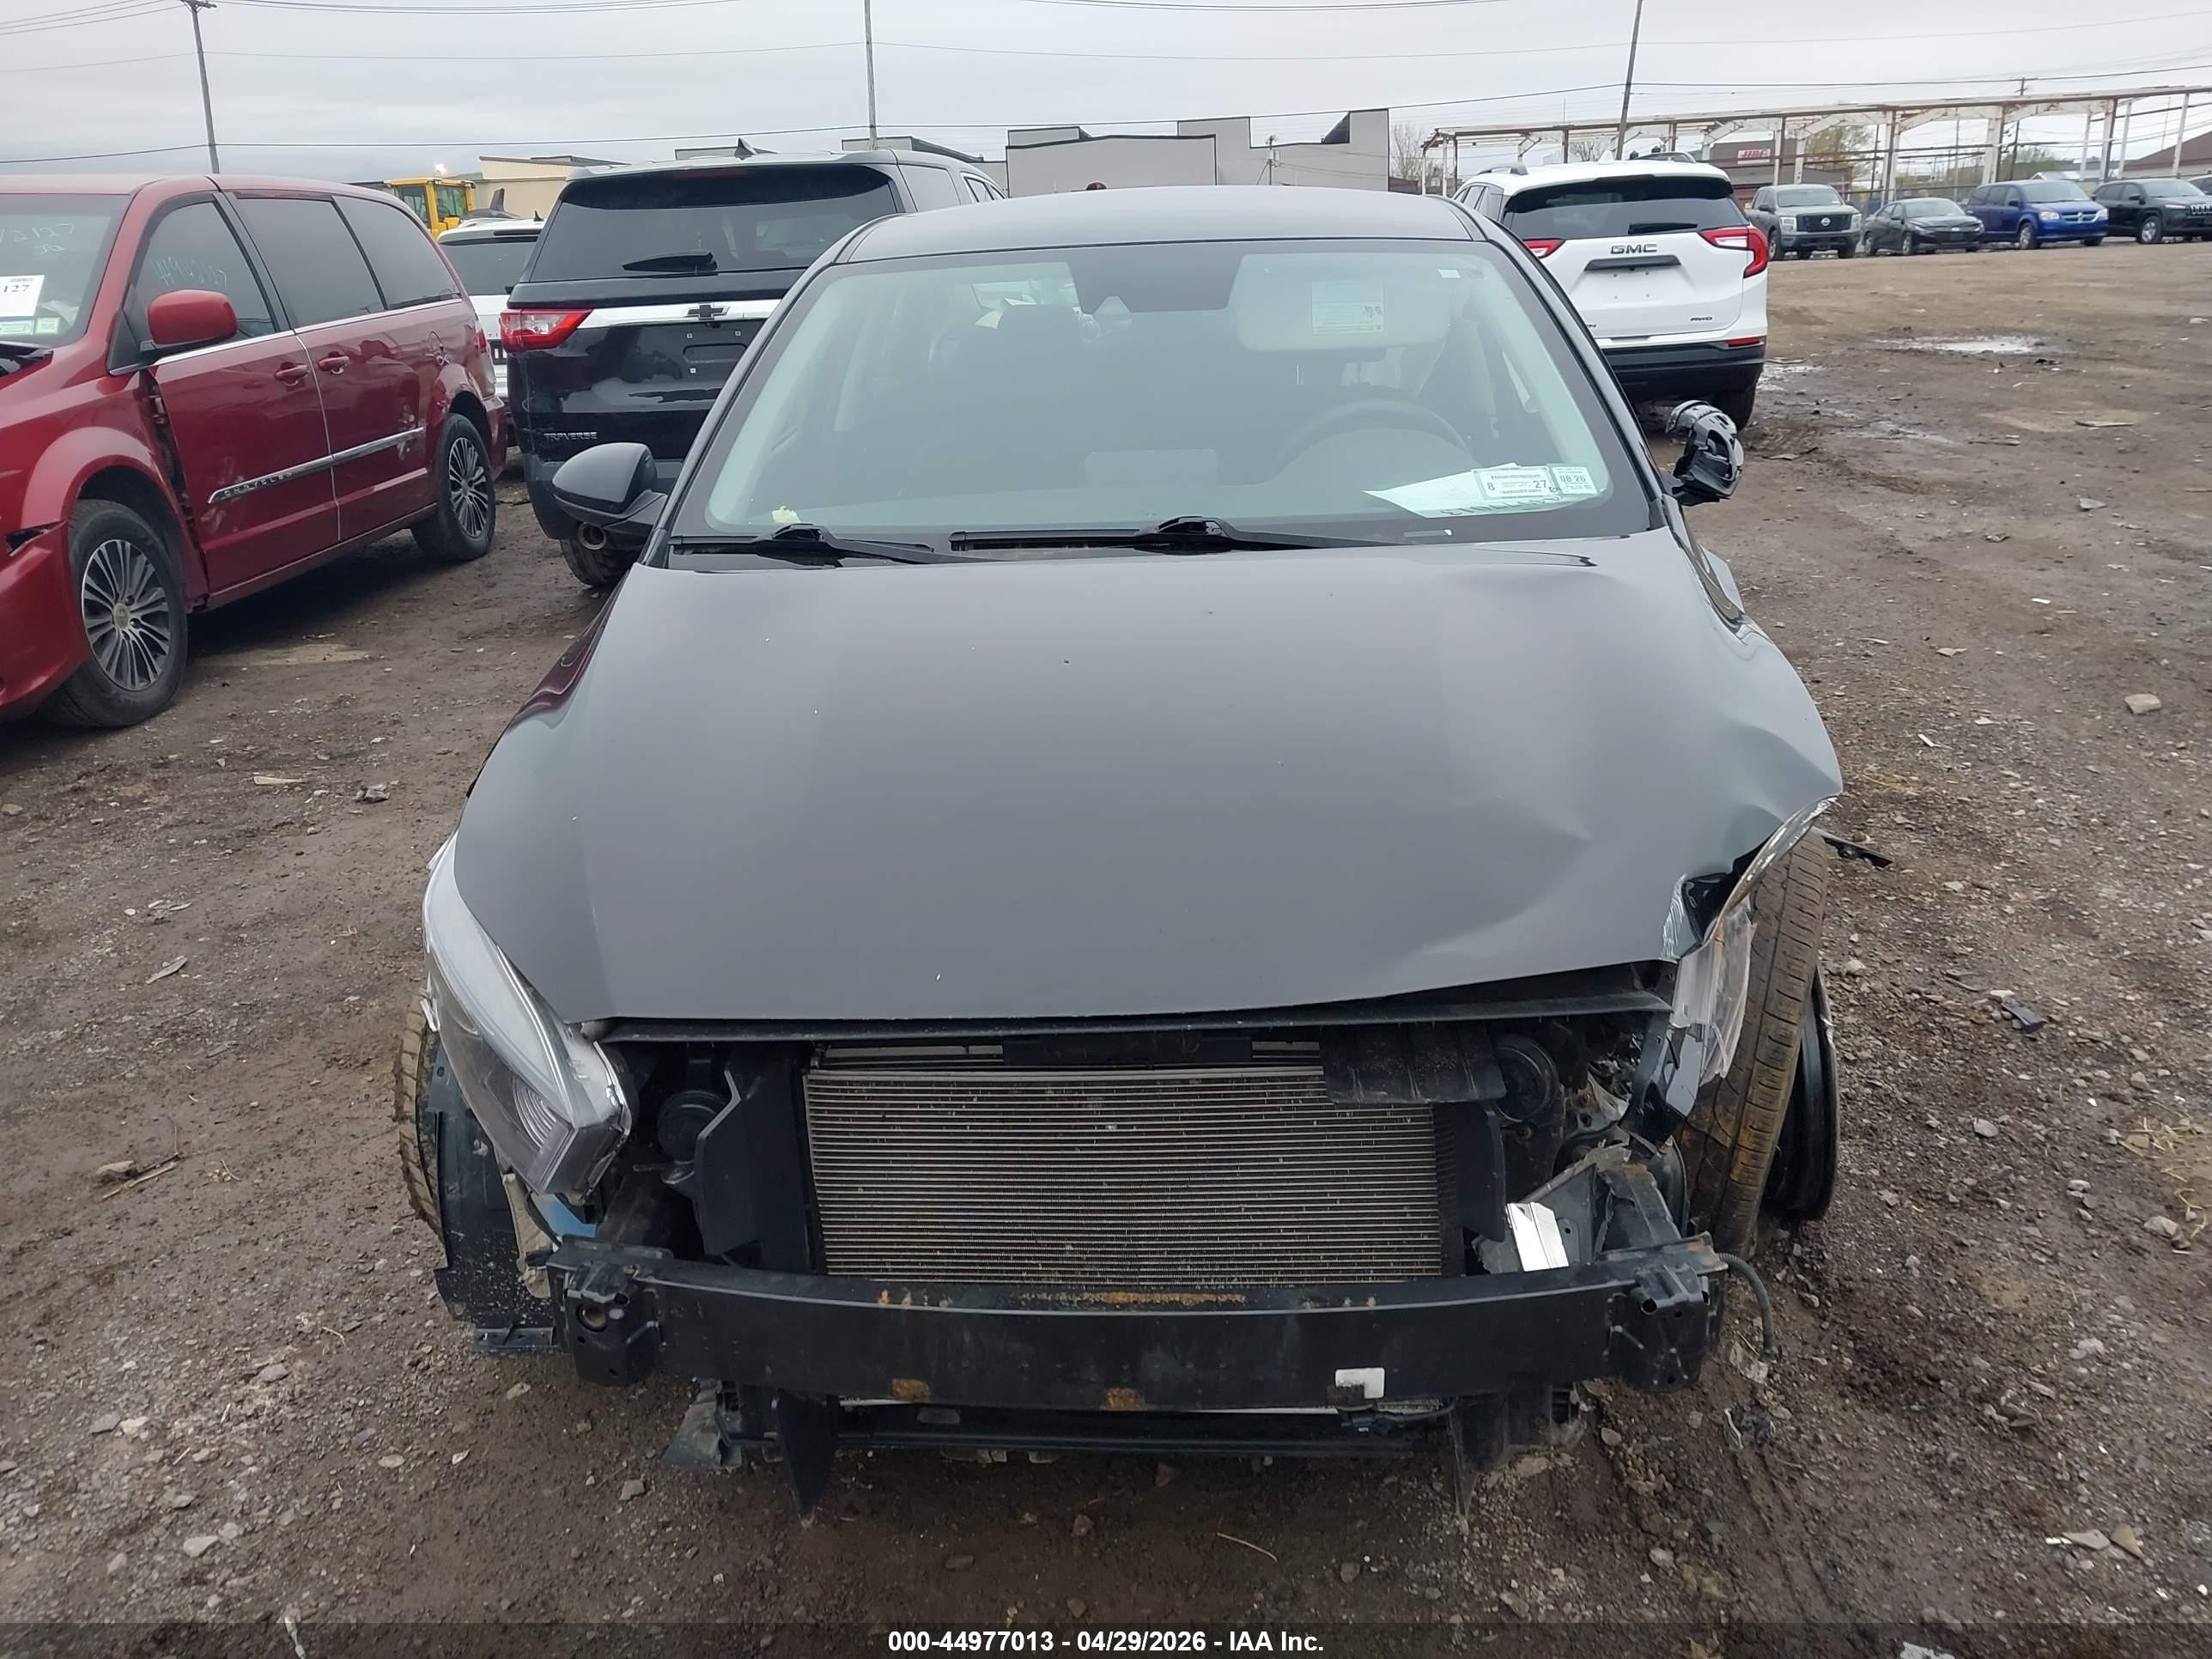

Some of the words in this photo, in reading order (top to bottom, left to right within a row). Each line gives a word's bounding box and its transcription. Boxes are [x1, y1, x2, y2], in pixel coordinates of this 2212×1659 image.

[1610, 243, 1657, 254] GMC
[543, 431, 599, 441] TRAVERSE
[223, 472, 293, 496] CHRYSLER
[1486, 482, 1496, 491] 8
[1533, 479, 1547, 489] 27
